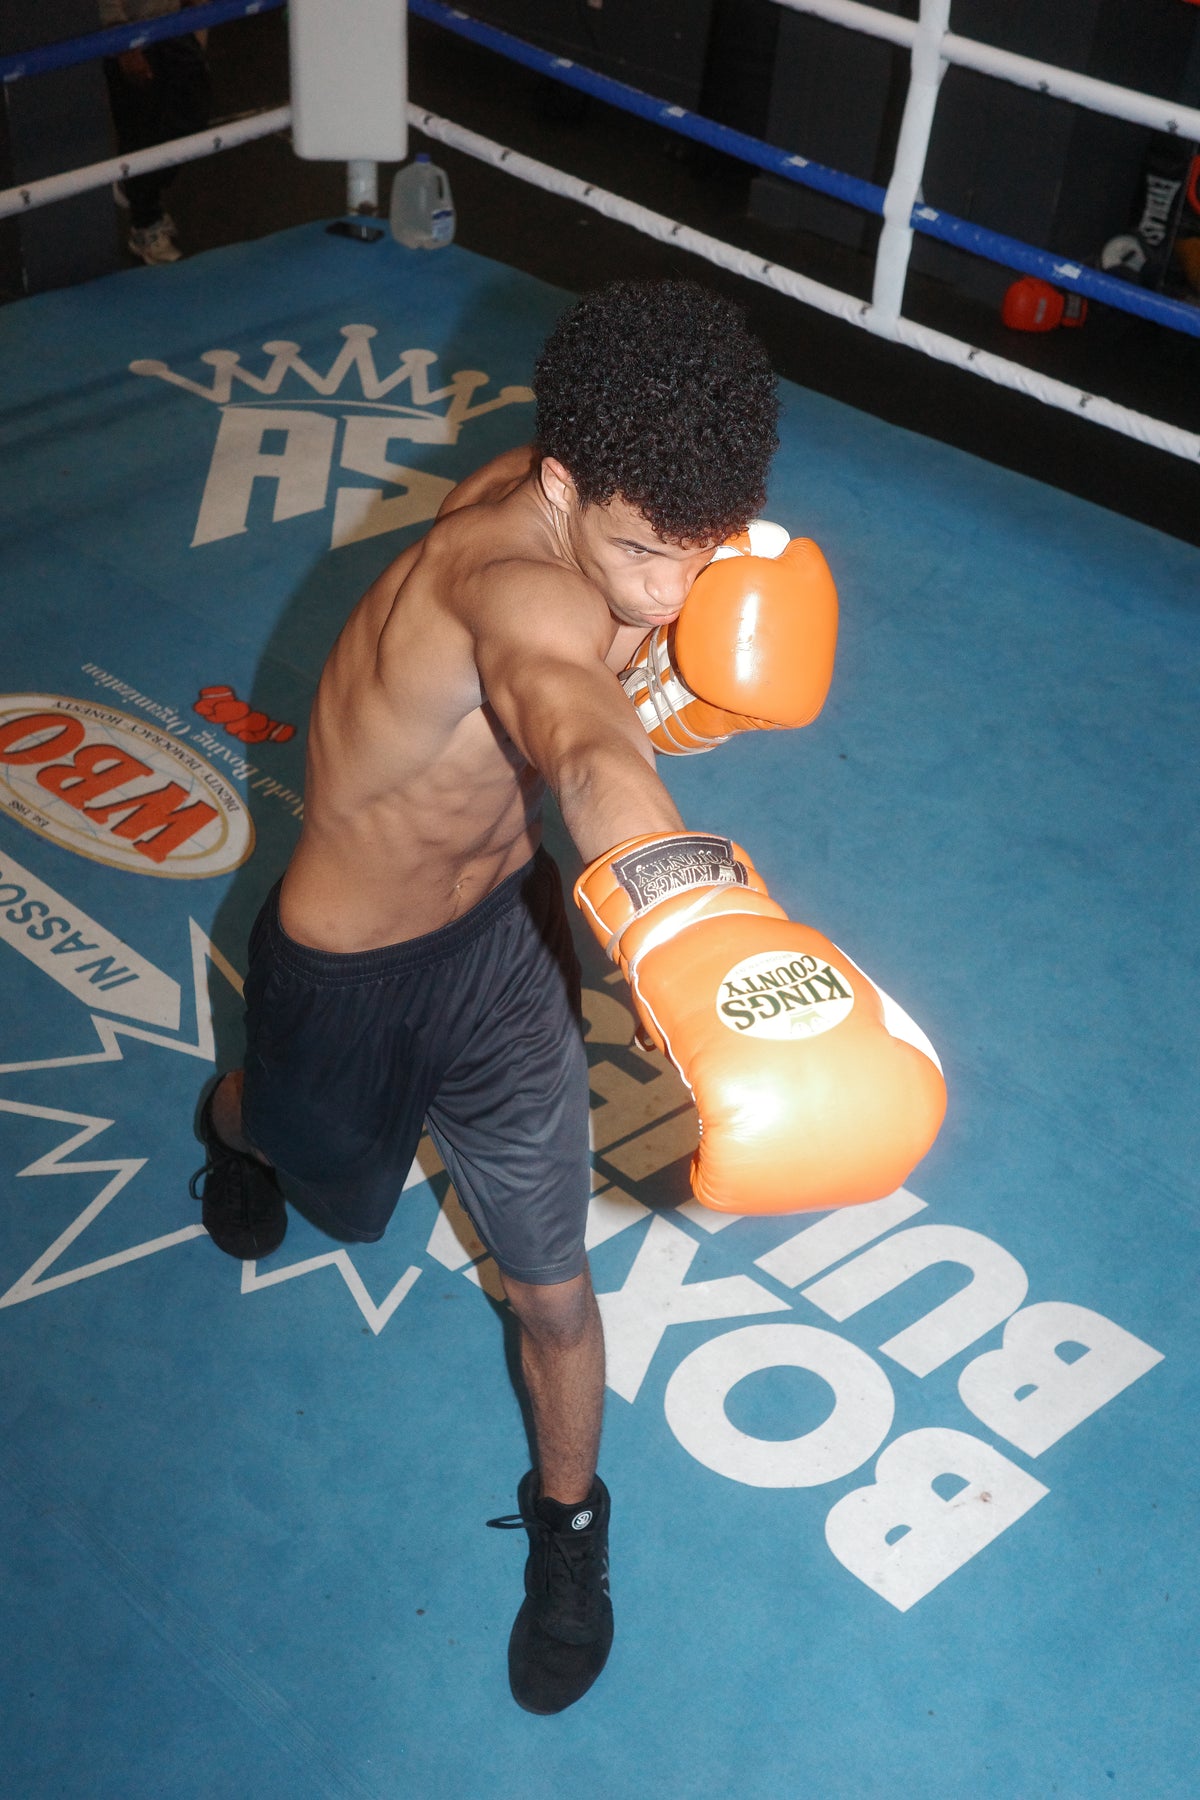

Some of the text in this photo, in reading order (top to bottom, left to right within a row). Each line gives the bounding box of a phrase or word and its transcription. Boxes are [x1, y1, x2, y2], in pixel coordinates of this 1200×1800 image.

[190, 406, 463, 550] AS
[81, 662, 192, 737] Organization
[0, 713, 219, 864] WBO
[52, 701, 240, 813] DIGNITY DEMOCRACY HONESTY
[191, 730, 258, 781] Boxing
[642, 864, 713, 903] KINGS
[0, 870, 139, 991] IN ASSO
[720, 965, 852, 1031] KINGS
[723, 955, 818, 998] COUNTY
